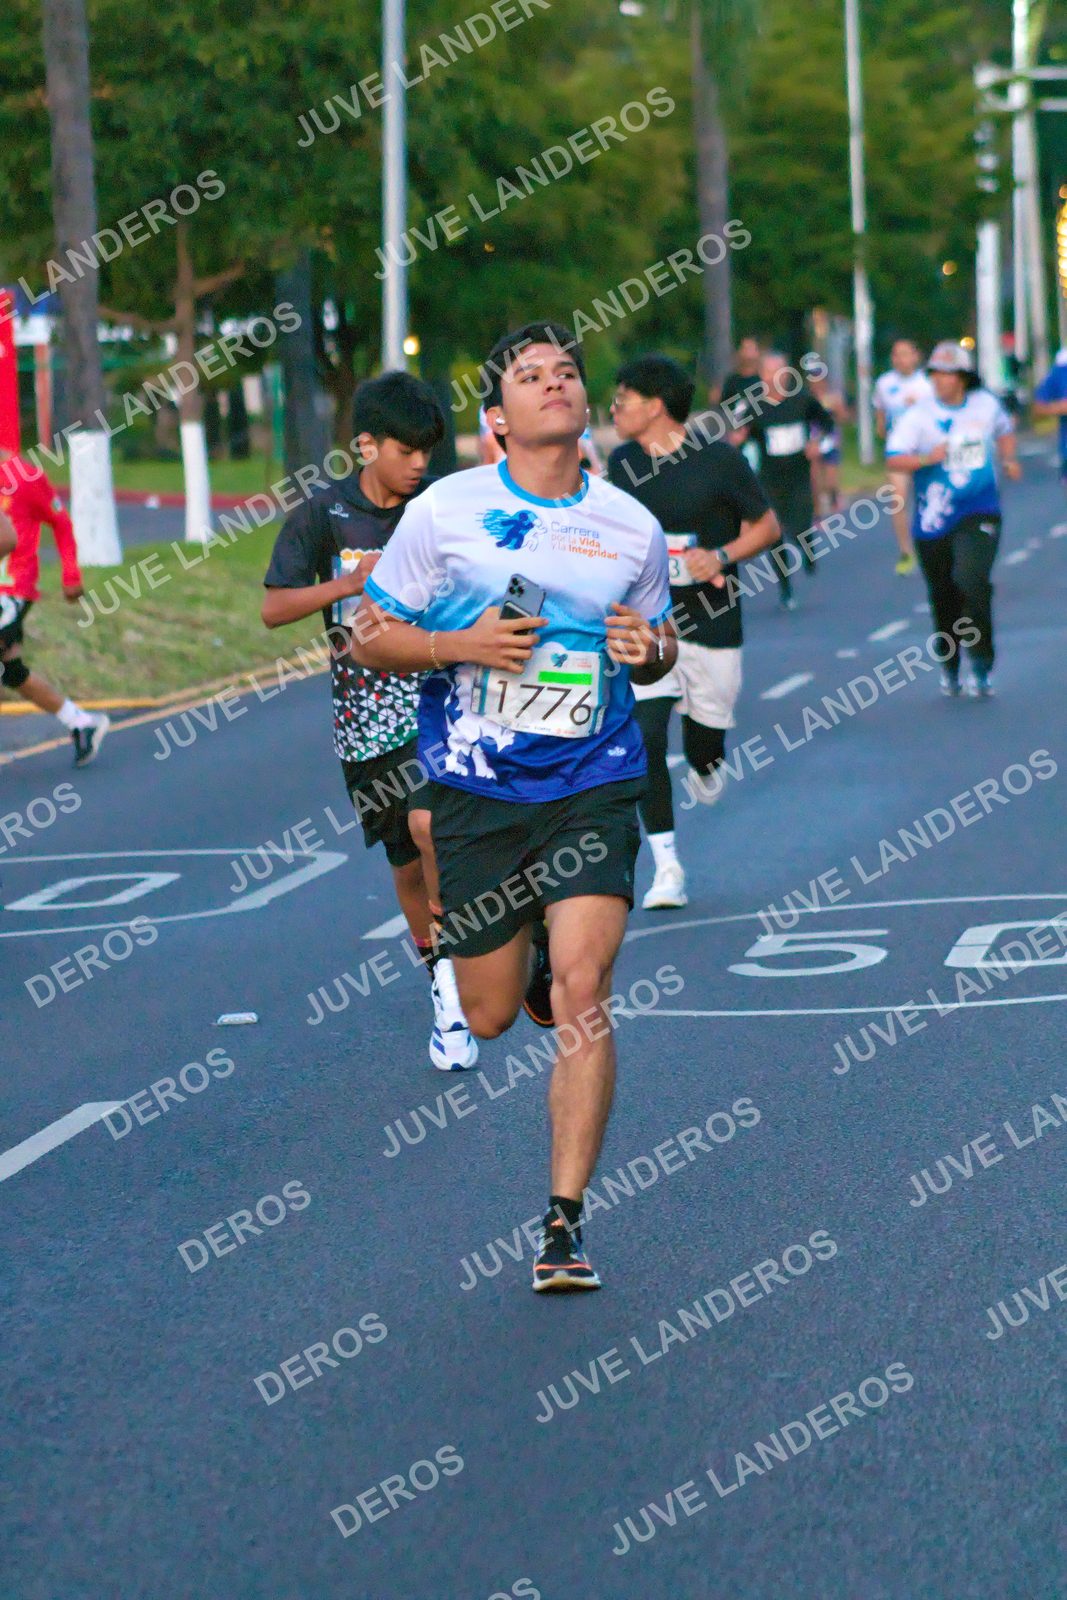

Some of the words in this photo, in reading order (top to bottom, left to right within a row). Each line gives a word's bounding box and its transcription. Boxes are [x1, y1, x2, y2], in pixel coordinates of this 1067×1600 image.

[551, 521, 599, 539] Carrera
[579, 537, 601, 548] Vida
[569, 544, 618, 561] Integridad
[497, 680, 592, 726] 1776
